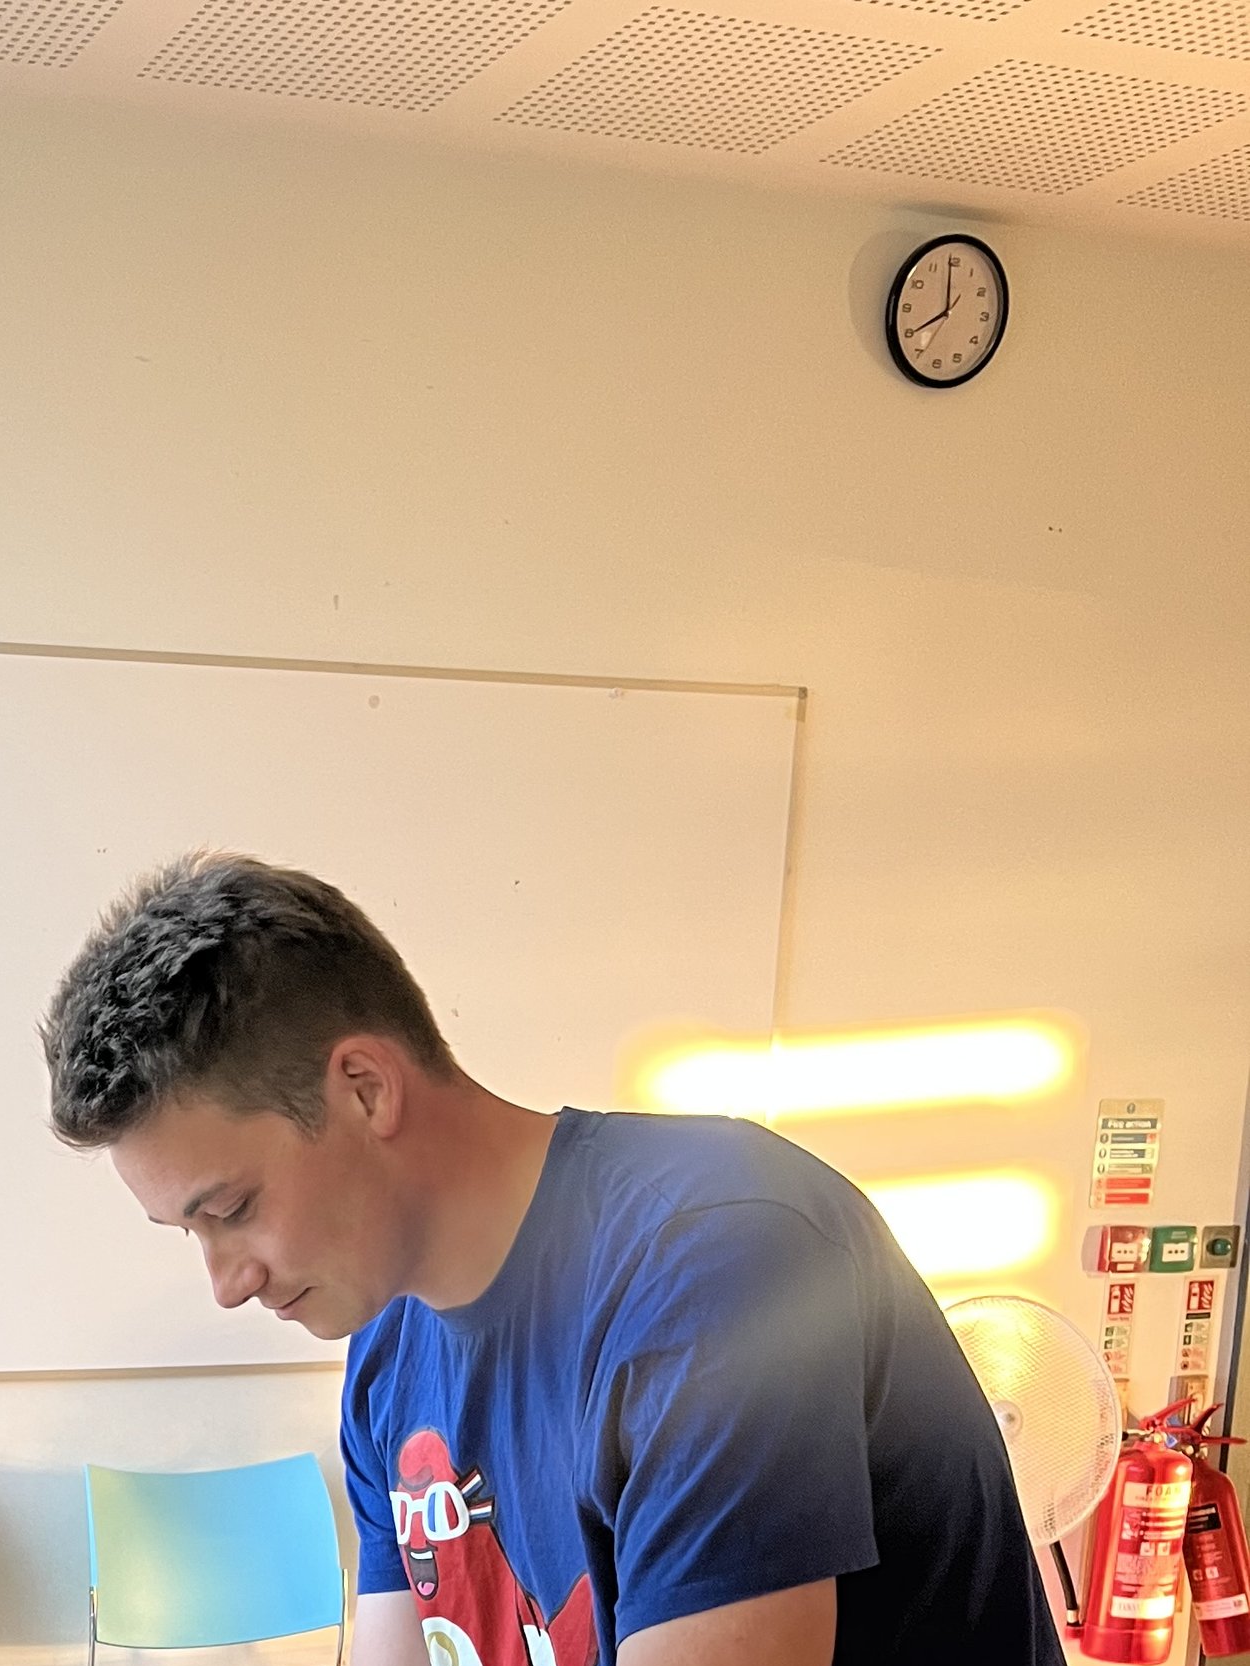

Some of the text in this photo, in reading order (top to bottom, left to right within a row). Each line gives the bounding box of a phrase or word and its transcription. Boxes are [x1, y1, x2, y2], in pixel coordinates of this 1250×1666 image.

[928, 263, 938, 272] 11
[969, 268, 974, 277] 1
[911, 280, 925, 289] 10
[976, 287, 987, 297] 2
[902, 303, 912, 313] 9
[979, 311, 990, 322] 3
[904, 328, 915, 338] 8
[969, 336, 979, 345] 4
[914, 348, 925, 359] 7
[952, 353, 963, 363] 5
[931, 359, 942, 369] 6
